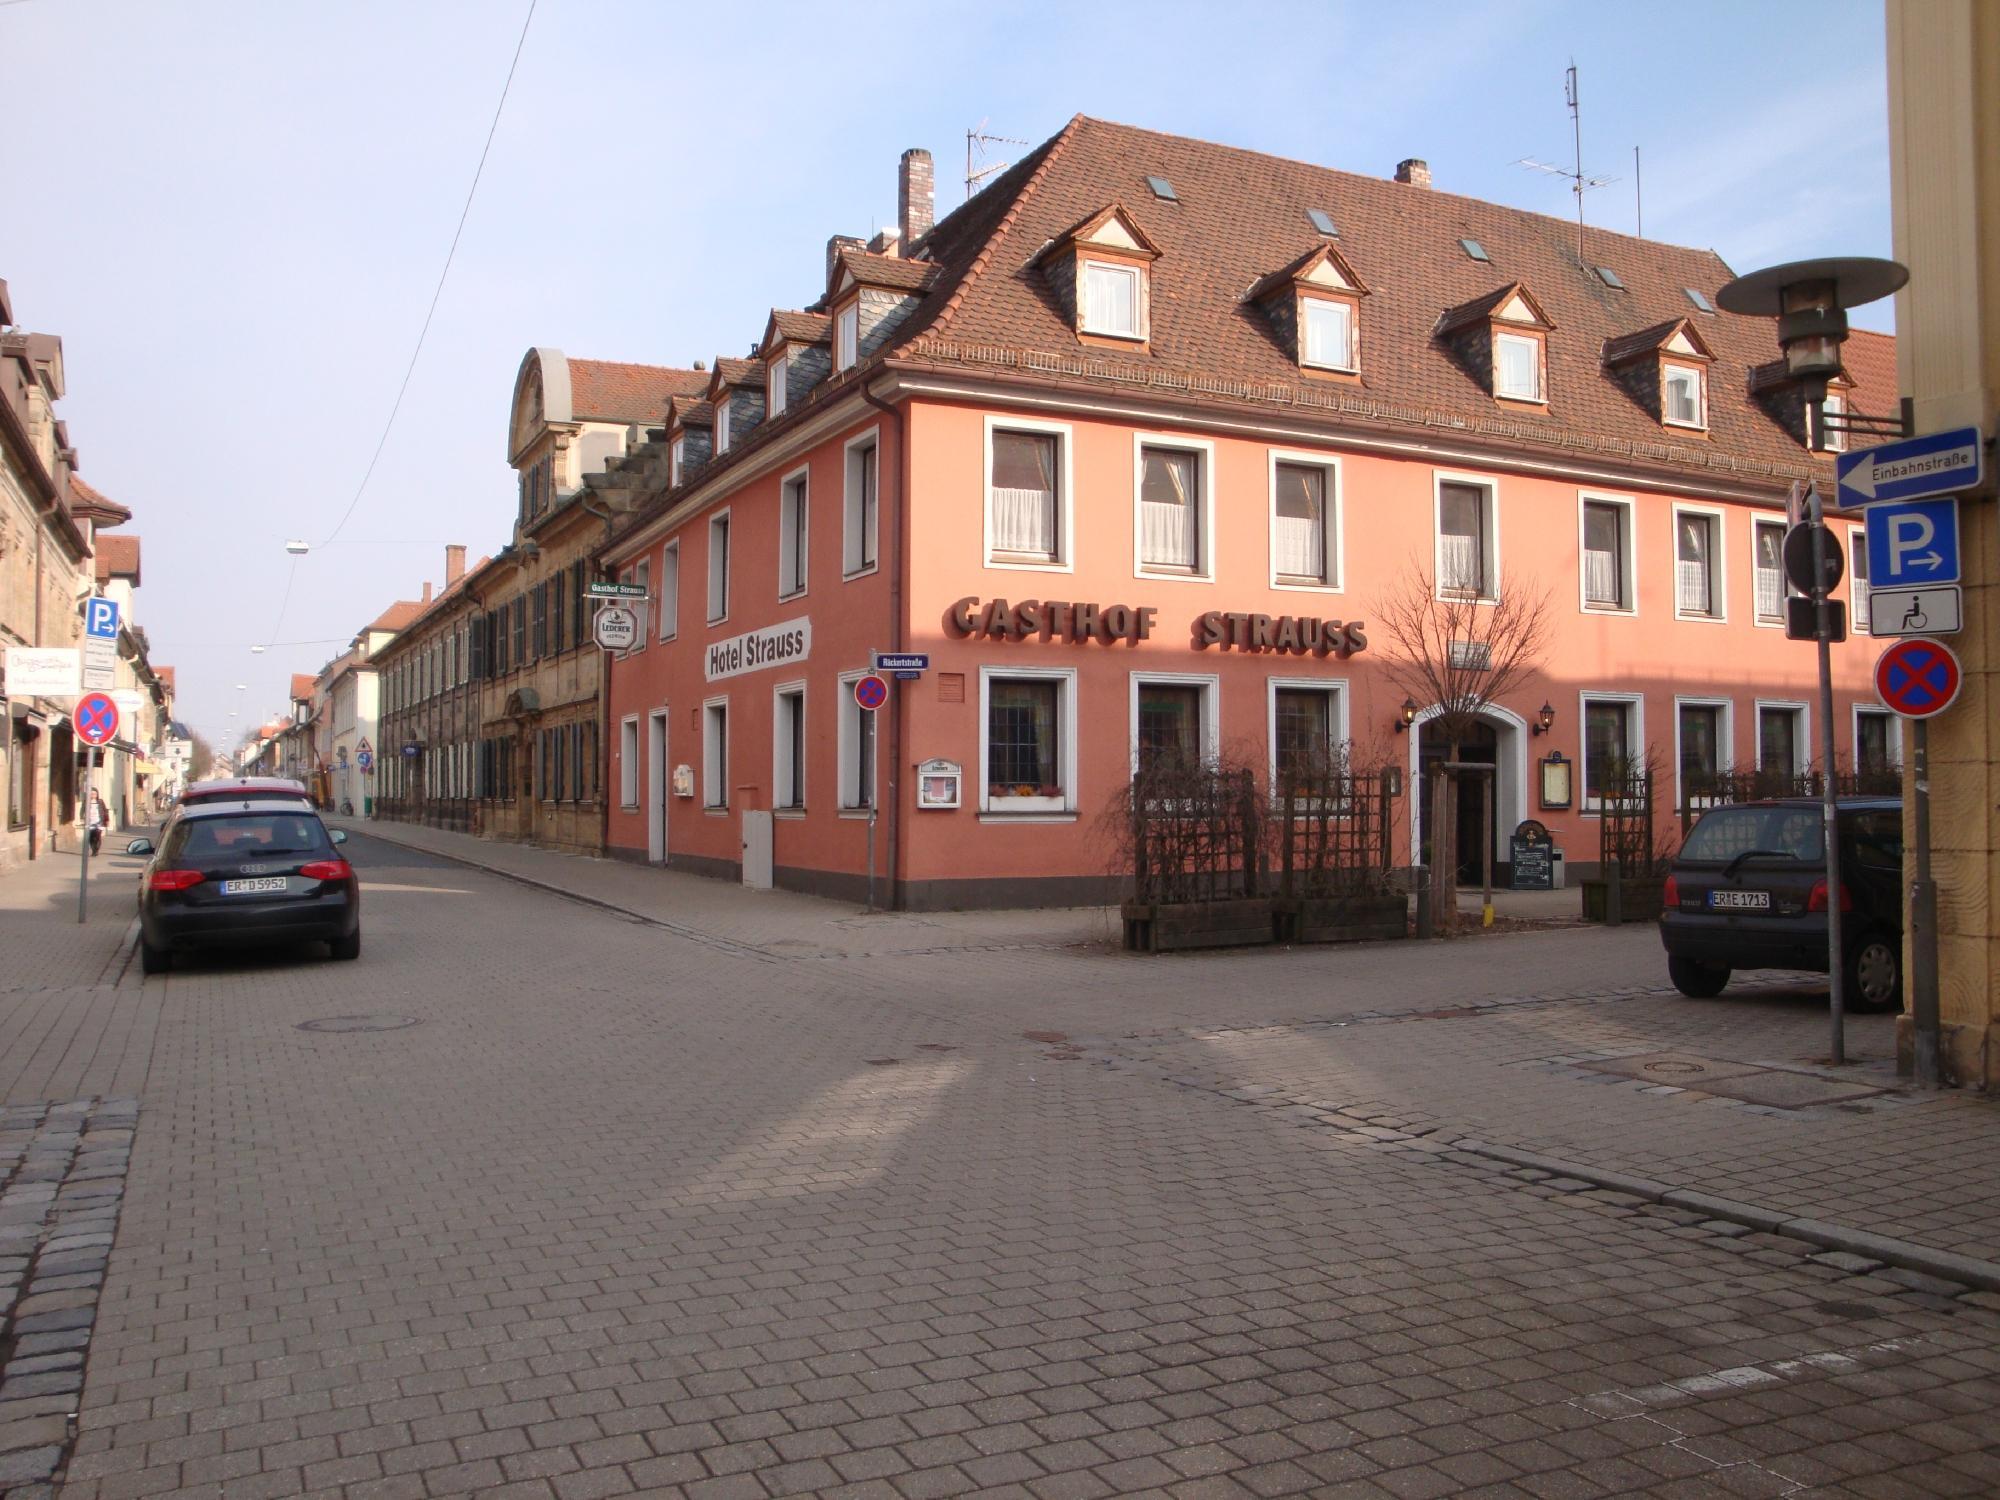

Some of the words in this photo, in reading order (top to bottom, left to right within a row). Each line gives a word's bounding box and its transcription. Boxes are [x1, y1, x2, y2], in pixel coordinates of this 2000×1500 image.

[1872, 452, 1968, 481] Einbahnstraße
[1888, 513, 1935, 576] P
[592, 584, 619, 592] Gasthof
[620, 585, 645, 594] Strauss
[93, 603, 112, 632] P
[953, 596, 1158, 640] GASTHOF
[1203, 611, 1368, 652] STRAUSS
[710, 638, 742, 675] Hotel
[746, 630, 803, 666] Strauss
[227, 880, 242, 892] ER
[248, 880, 256, 891] D
[257, 878, 285, 890] 5952
[1713, 892, 1726, 905] ER
[1732, 893, 1739, 906] E
[1741, 894, 1768, 907] 1713
